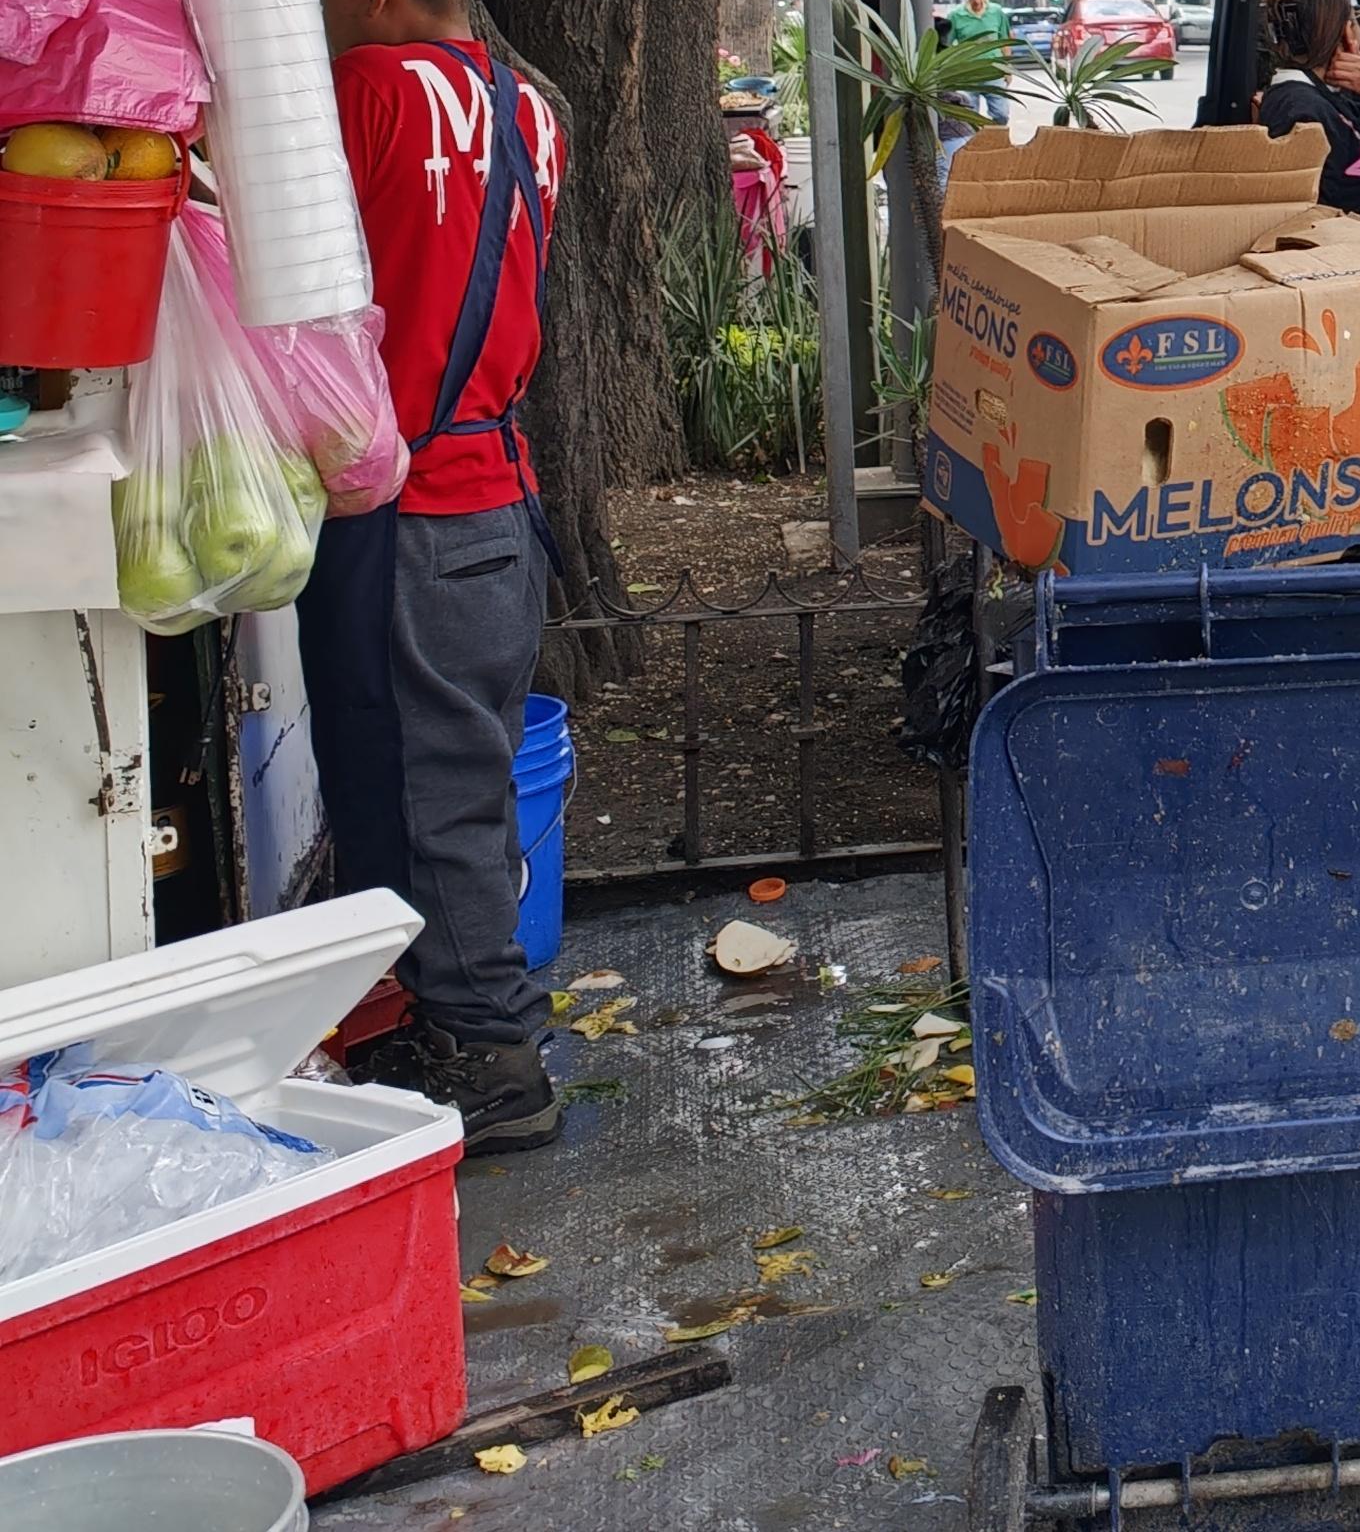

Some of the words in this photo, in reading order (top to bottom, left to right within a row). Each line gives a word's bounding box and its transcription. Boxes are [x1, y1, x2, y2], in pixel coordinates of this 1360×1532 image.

[942, 278, 1019, 359] MELONS
[1045, 345, 1071, 372] FSL
[1156, 328, 1225, 358] FSL
[1223, 524, 1299, 558] premium
[1298, 511, 1359, 546] quality
[78, 1286, 268, 1388] IGLOO
